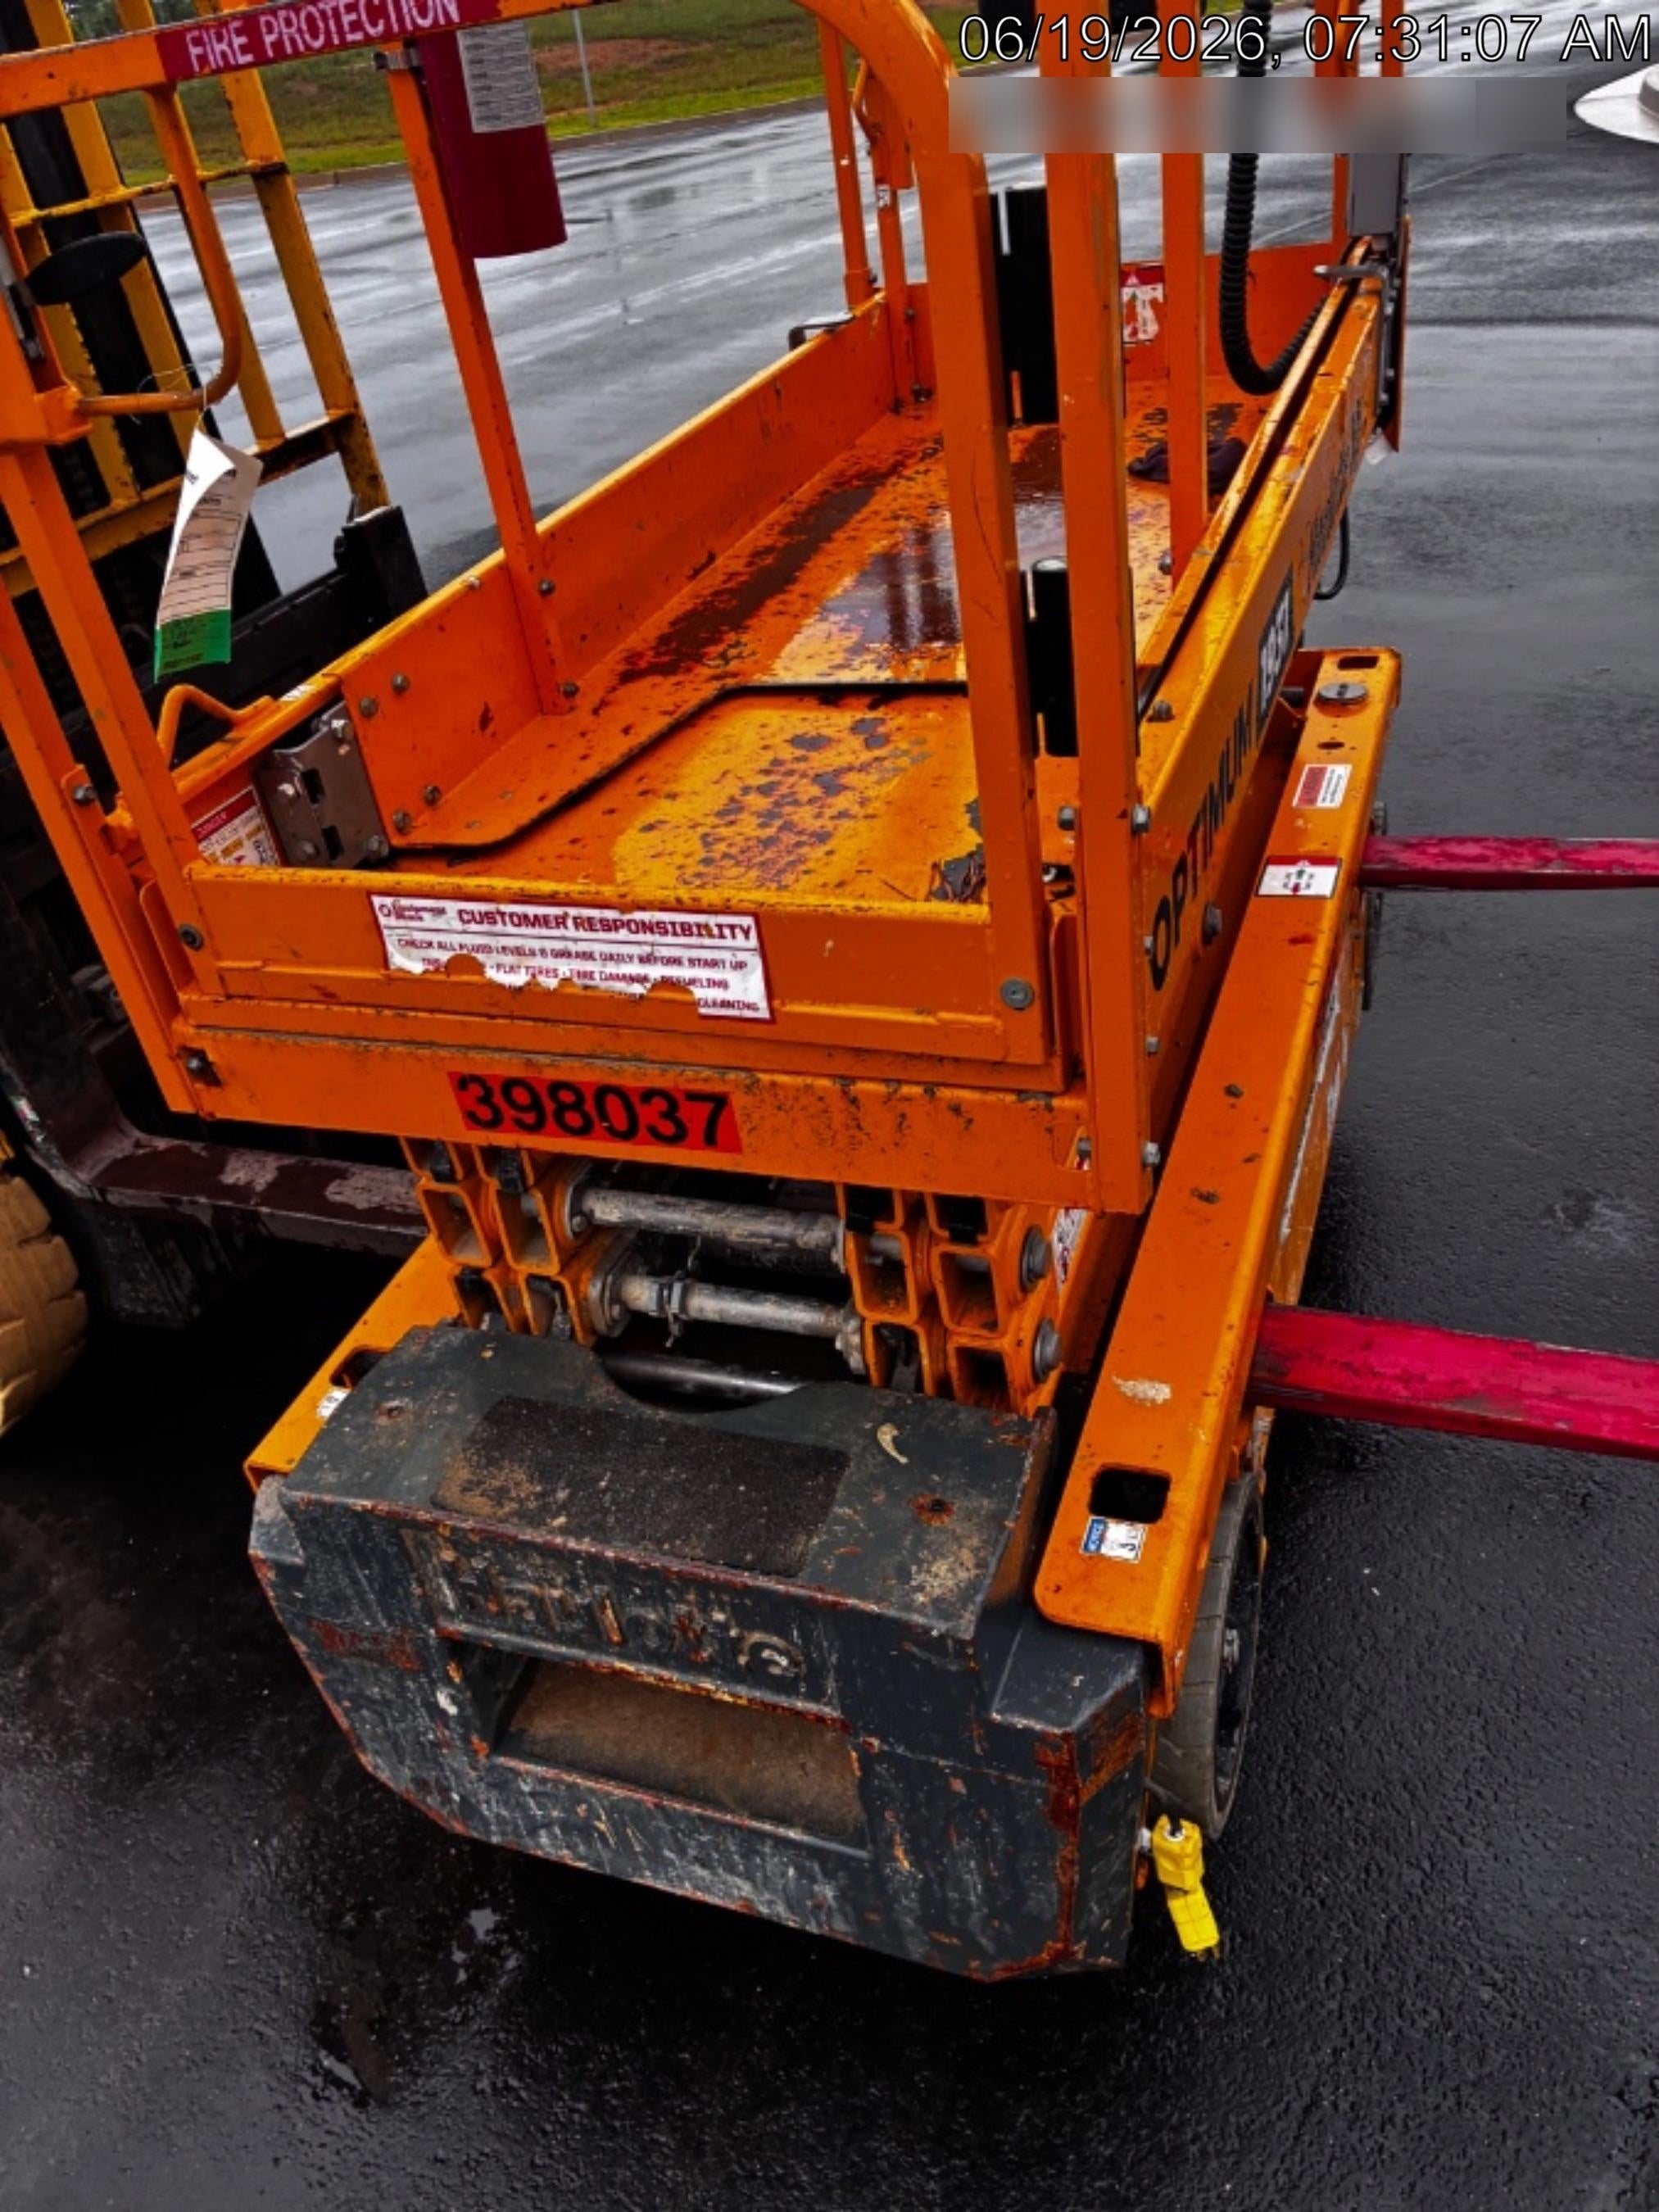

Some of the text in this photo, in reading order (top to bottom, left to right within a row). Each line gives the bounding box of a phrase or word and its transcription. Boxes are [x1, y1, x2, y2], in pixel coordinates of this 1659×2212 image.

[185, 0, 460, 74] FIRE PROTECTION
[457, 907, 569, 930] CUSTOMER
[573, 915, 752, 941] RESPONSIBILITY
[599, 951, 635, 963] DAILY
[687, 957, 726, 970] START
[729, 959, 748, 972] UP
[456, 1073, 729, 1147] 398037
